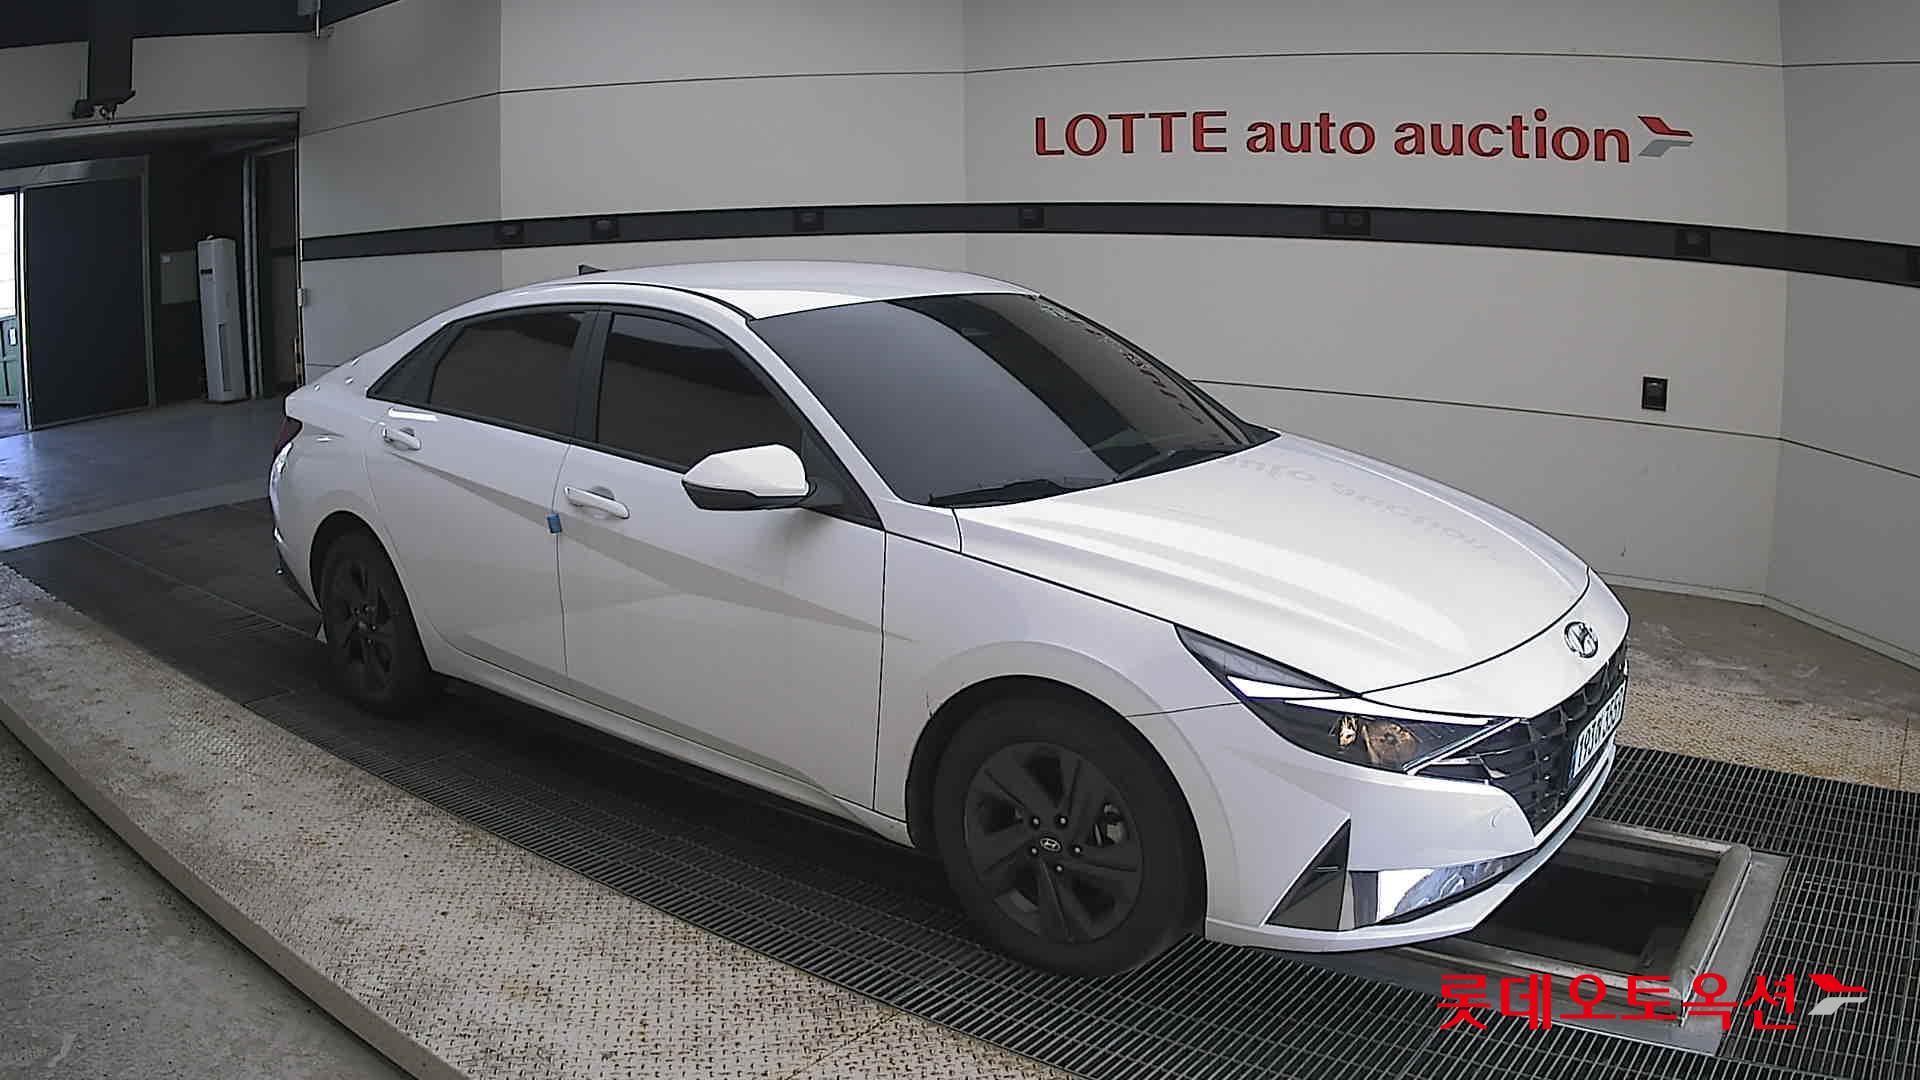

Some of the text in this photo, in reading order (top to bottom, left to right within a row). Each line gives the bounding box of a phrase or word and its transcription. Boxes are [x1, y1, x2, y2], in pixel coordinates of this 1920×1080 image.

[1035, 108, 1630, 163] LOTTE auto auction
